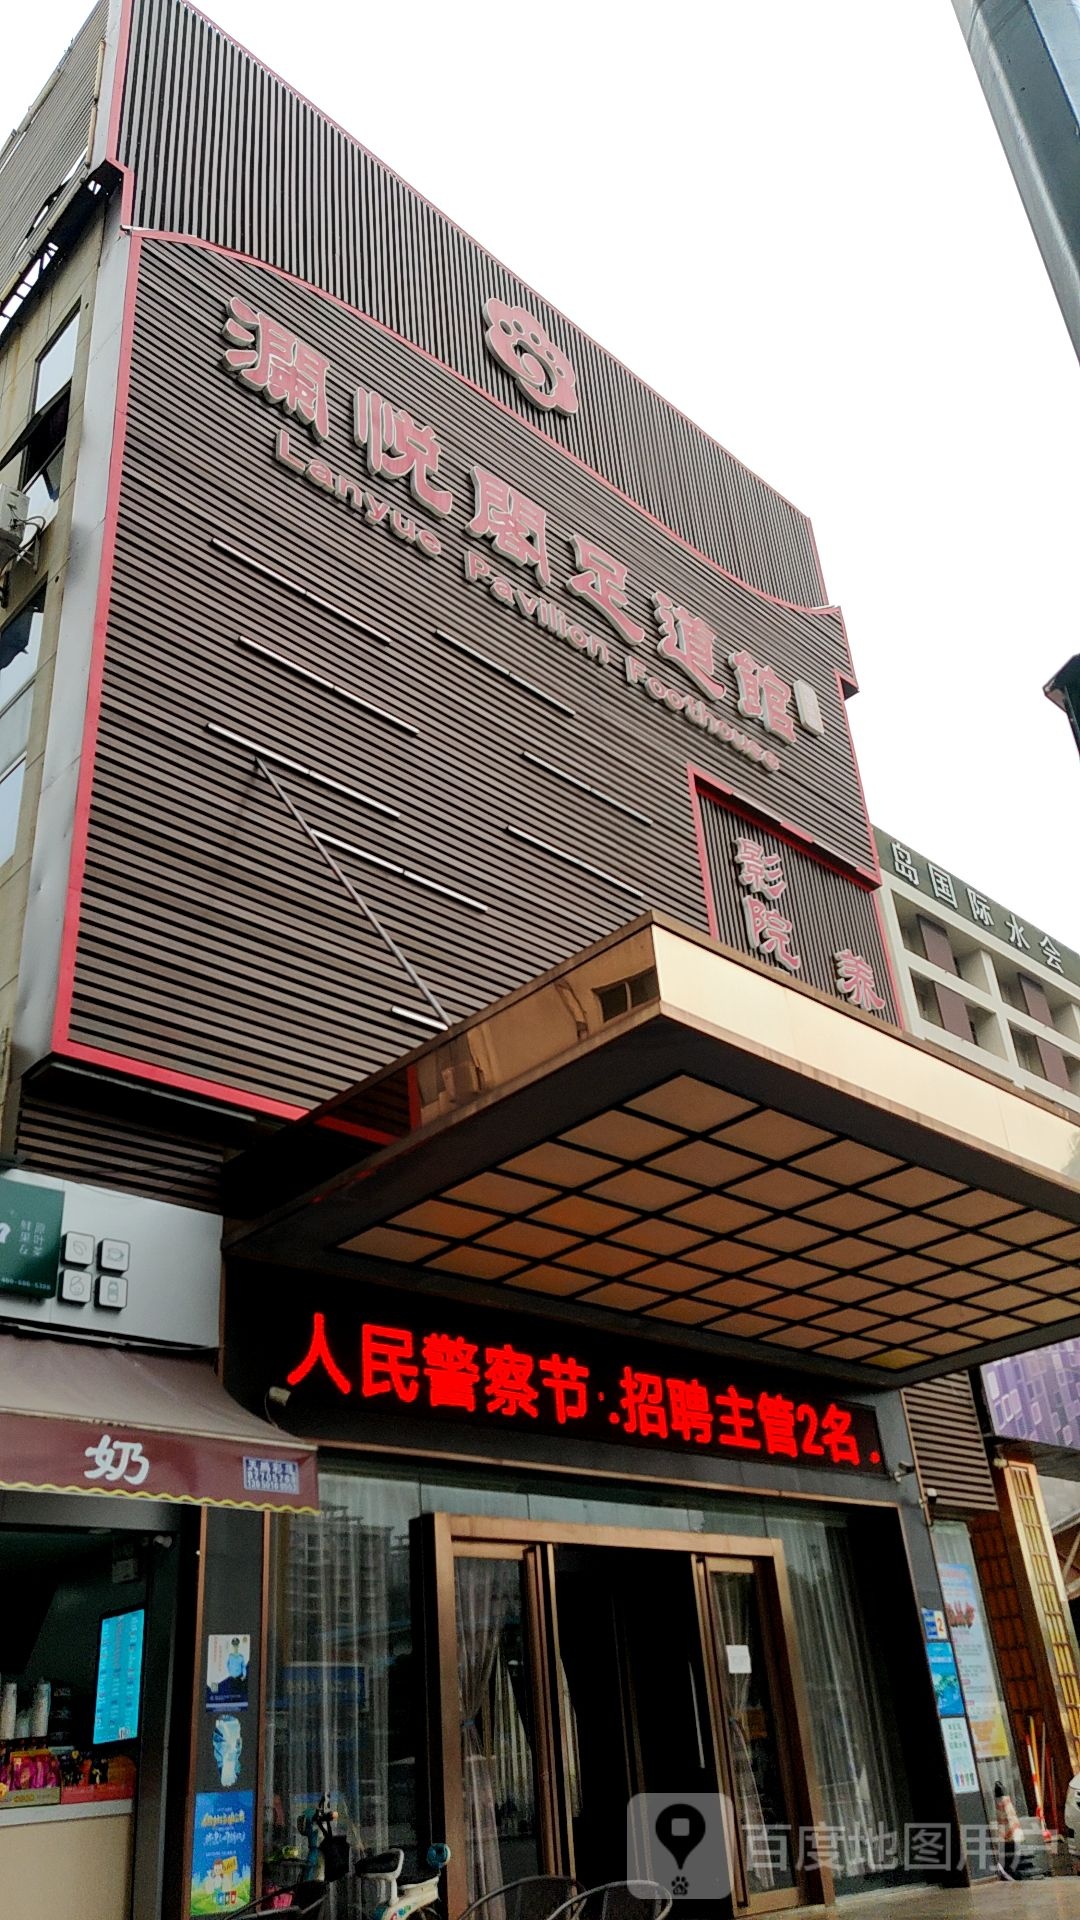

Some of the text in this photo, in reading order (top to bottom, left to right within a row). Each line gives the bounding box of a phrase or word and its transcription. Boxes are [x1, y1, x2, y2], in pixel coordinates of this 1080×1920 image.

[734, 837, 801, 972] 影院
[891, 842, 1065, 974] 岛国际水会
[84, 1434, 149, 1485] 奶
